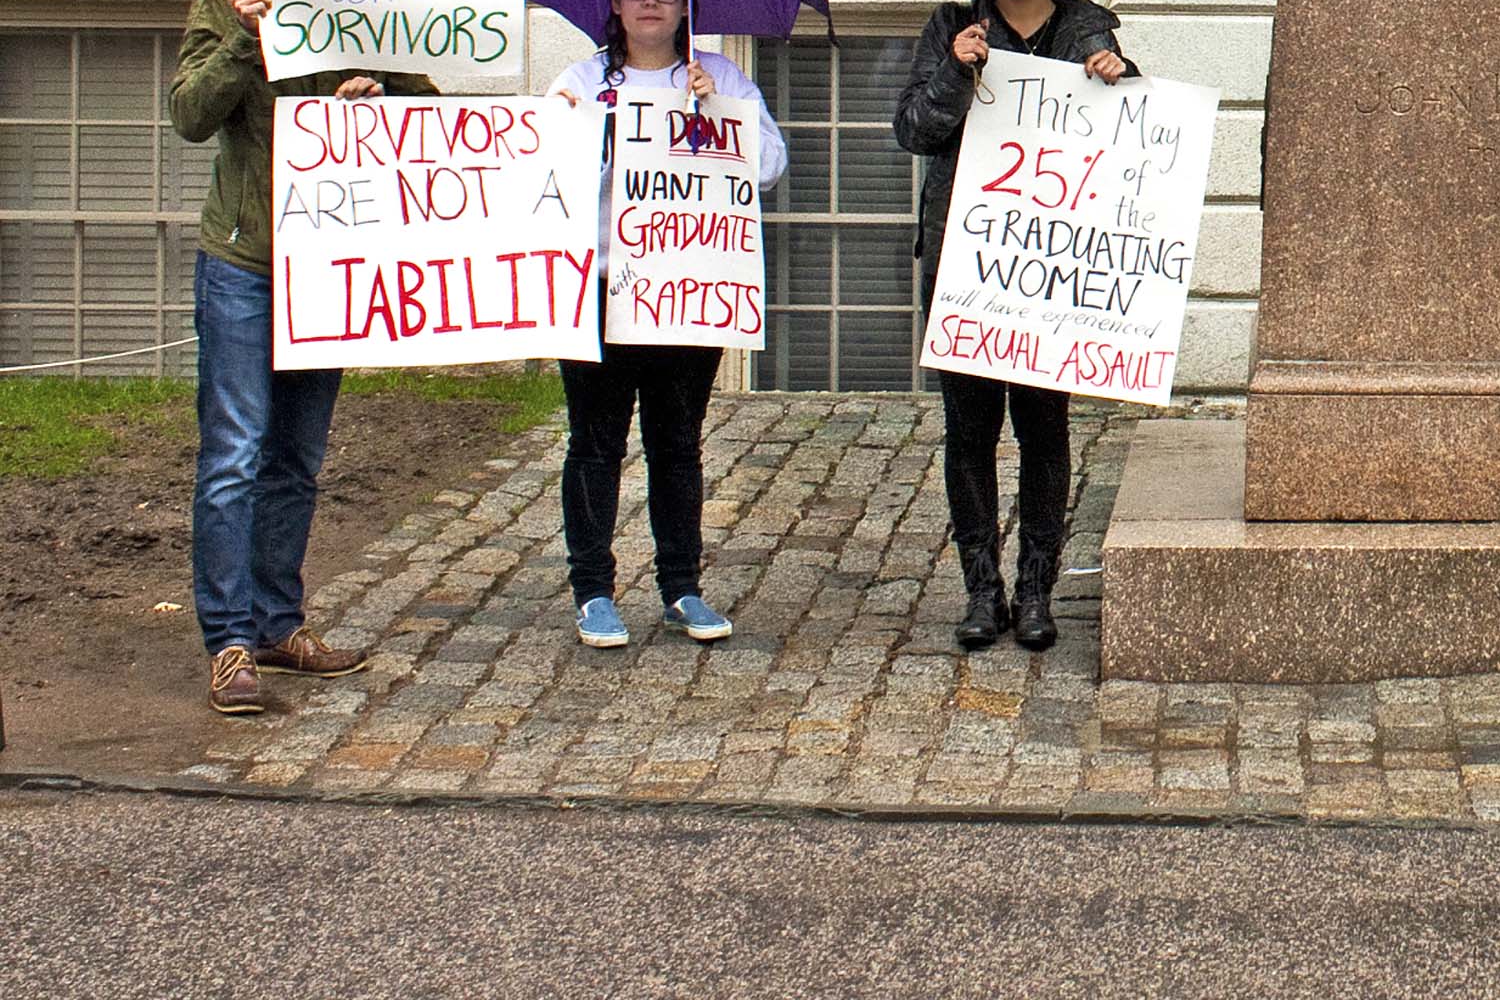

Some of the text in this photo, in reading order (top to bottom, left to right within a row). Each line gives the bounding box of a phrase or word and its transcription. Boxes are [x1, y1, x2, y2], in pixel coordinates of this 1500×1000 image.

[273, 1, 508, 63] SURVIVORS
[626, 102, 654, 142] I
[1008, 77, 1181, 174] This May
[1355, 70, 1473, 115] JOHN
[287, 99, 539, 171] SURVIVORS
[277, 165, 570, 232] ARE NOT A
[625, 168, 753, 206] WANT TO
[980, 141, 1149, 211] 25% of
[617, 206, 758, 259] GRADUATE
[963, 204, 1192, 284] GRADUATING
[1114, 195, 1156, 233] the
[284, 248, 595, 344] LIABILITY
[609, 262, 761, 334] with RAPISTS
[940, 289, 1162, 339] will have experienced
[976, 250, 1142, 316] WOMEN
[930, 315, 1174, 391] SEXUAL ASSAULT
